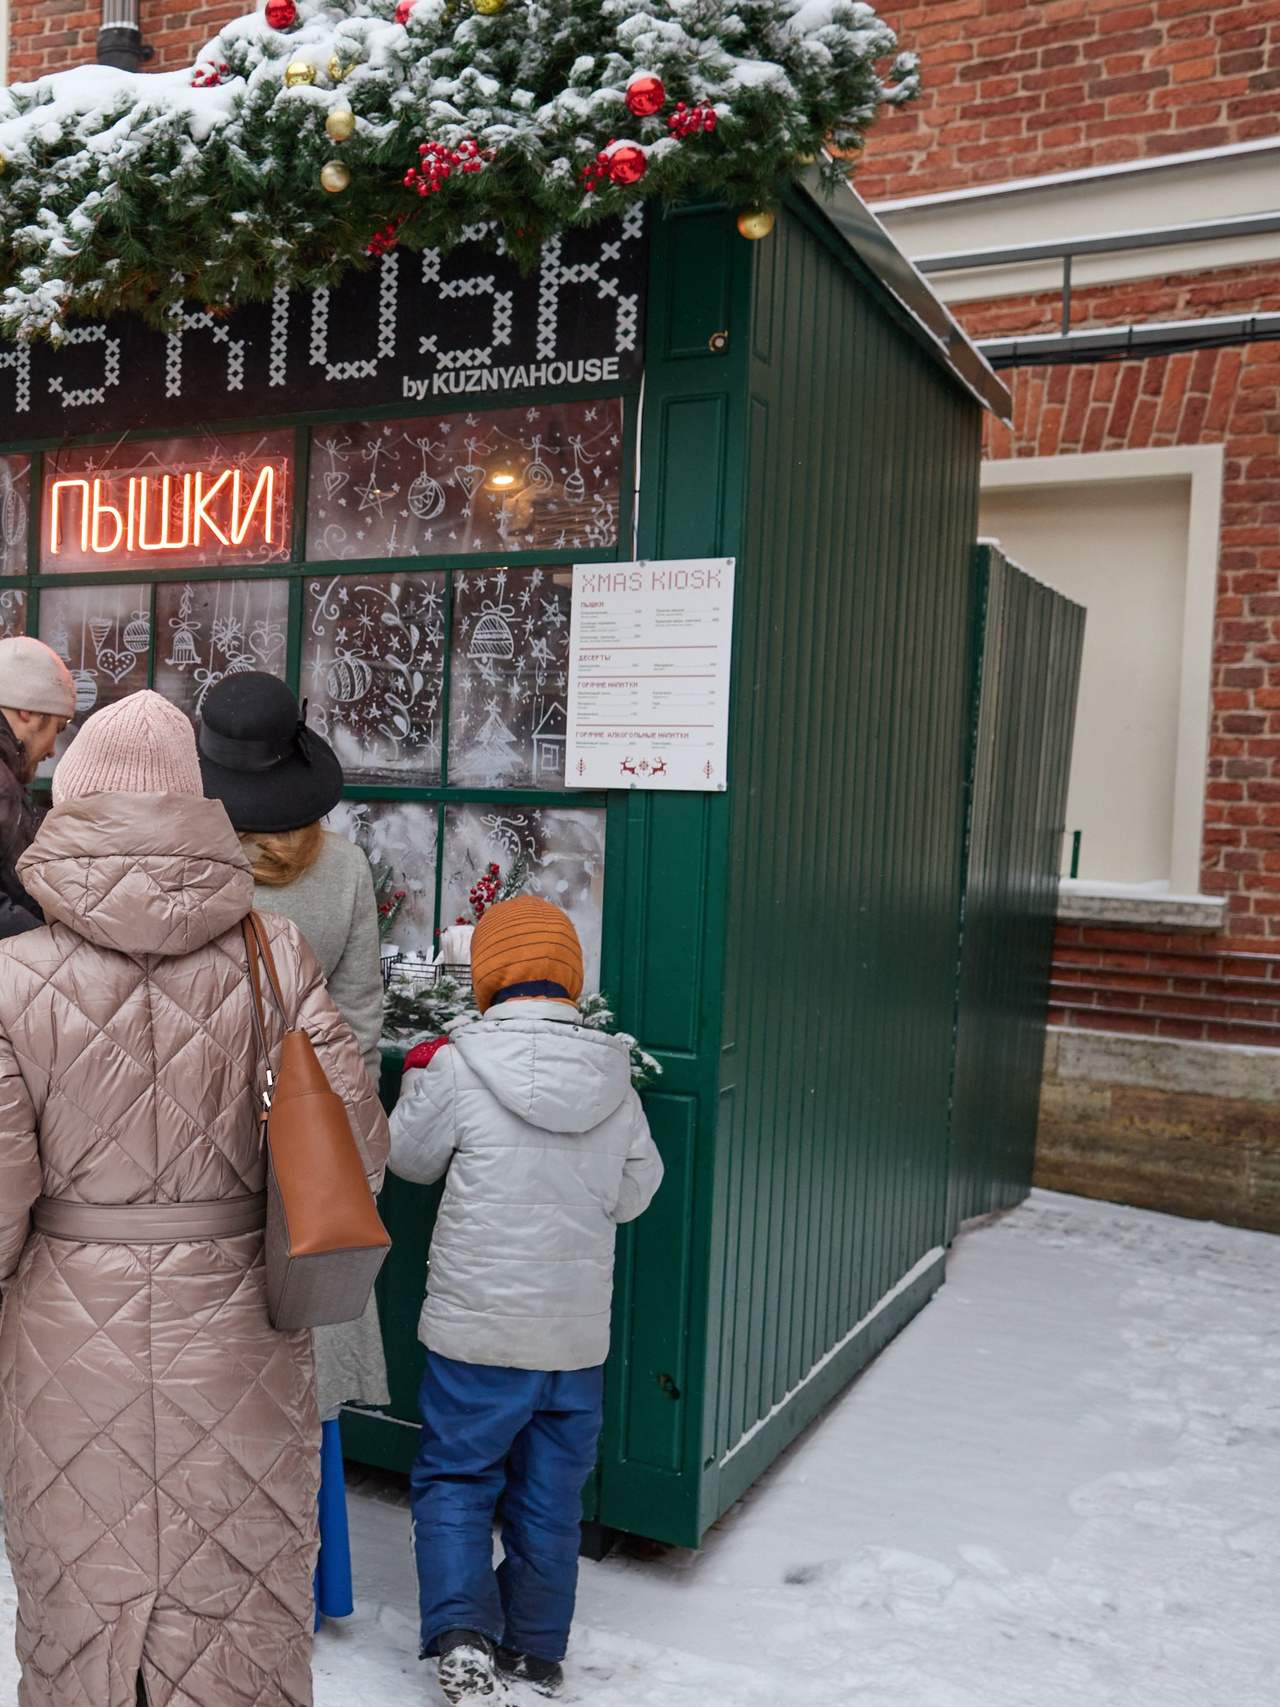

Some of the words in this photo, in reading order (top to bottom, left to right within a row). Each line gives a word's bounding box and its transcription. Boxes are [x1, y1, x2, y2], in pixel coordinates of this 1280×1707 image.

[402, 376, 429, 400] by
[432, 356, 620, 395] KUZNYAHOUSE
[50, 465, 274, 554] ПЫШКИ
[581, 572, 643, 593] XMAS
[651, 569, 722, 591] KIOSK
